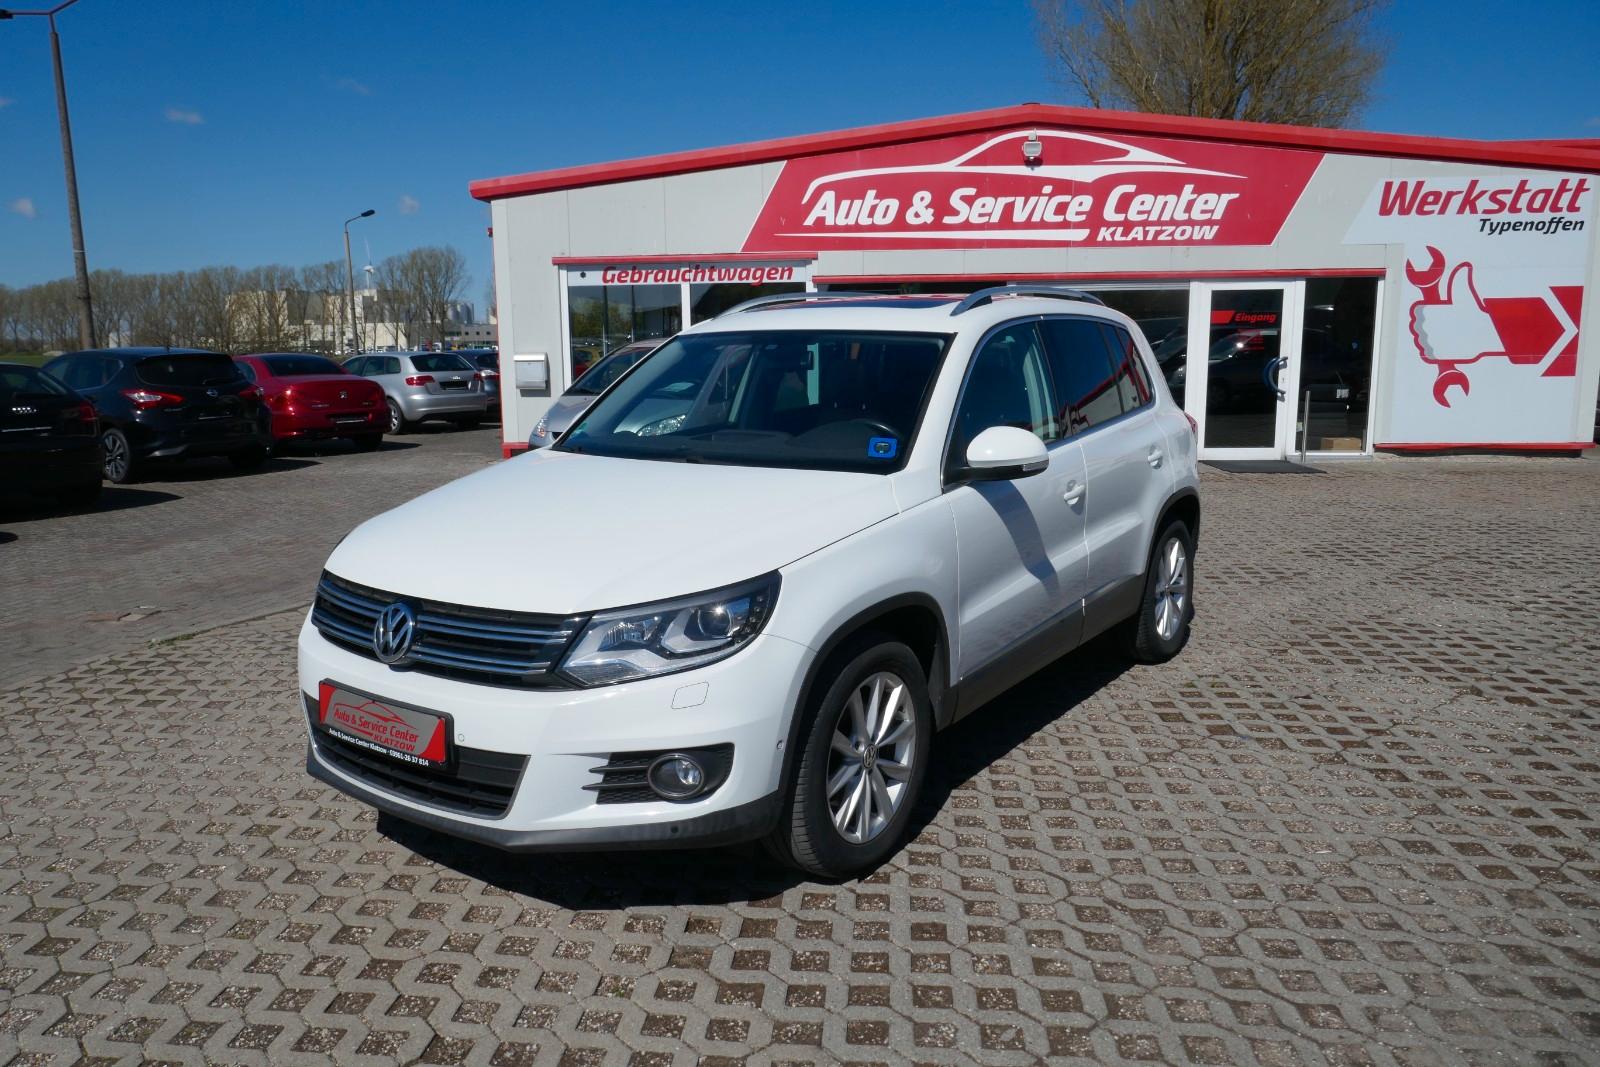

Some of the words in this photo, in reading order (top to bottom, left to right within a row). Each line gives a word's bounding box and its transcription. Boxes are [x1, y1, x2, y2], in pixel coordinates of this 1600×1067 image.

[803, 190, 900, 226] Auto
[905, 190, 935, 225] &
[942, 187, 1093, 224] Service
[1103, 184, 1240, 222] Center
[1379, 178, 1591, 216] Werkstatt
[1096, 225, 1219, 241] KLATZOW
[1479, 217, 1585, 235] Typenoffen
[602, 264, 794, 287] Gebrauchtwagen
[1234, 312, 1278, 324] Eingang
[334, 708, 350, 722] Auto
[351, 714, 357, 725] &
[357, 716, 388, 735] Service
[390, 725, 418, 743] Center
[341, 732, 355, 743] Service
[356, 738, 370, 748] Center
[373, 734, 416, 752] KLATZOW
